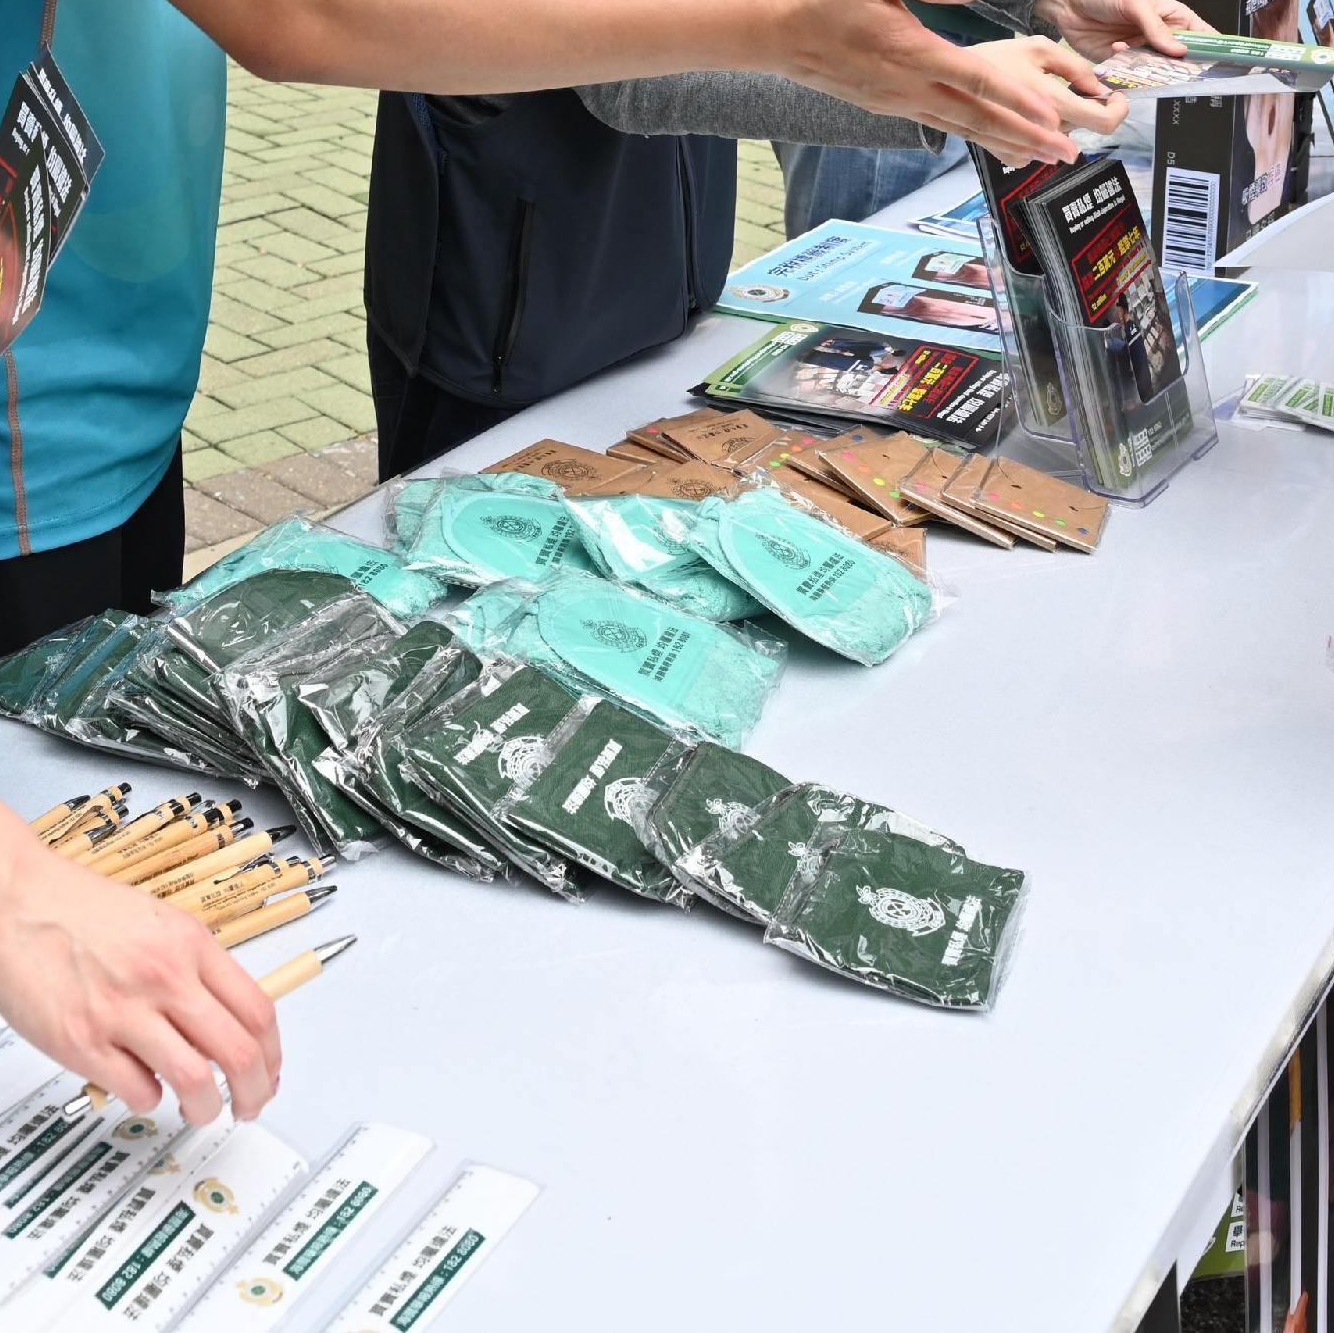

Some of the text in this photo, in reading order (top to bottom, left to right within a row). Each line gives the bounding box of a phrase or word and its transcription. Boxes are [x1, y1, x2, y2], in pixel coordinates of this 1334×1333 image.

[7, 1105, 59, 1145] 均屬違法
[37, 1133, 56, 1147] 182
[305, 1178, 352, 1220] 均屬違法
[336, 1205, 354, 1225] 182
[412, 1225, 457, 1269] 均屬違法
[122, 1262, 142, 1280] 182
[443, 1254, 462, 1273] 182
[101, 1277, 127, 1302] 8080
